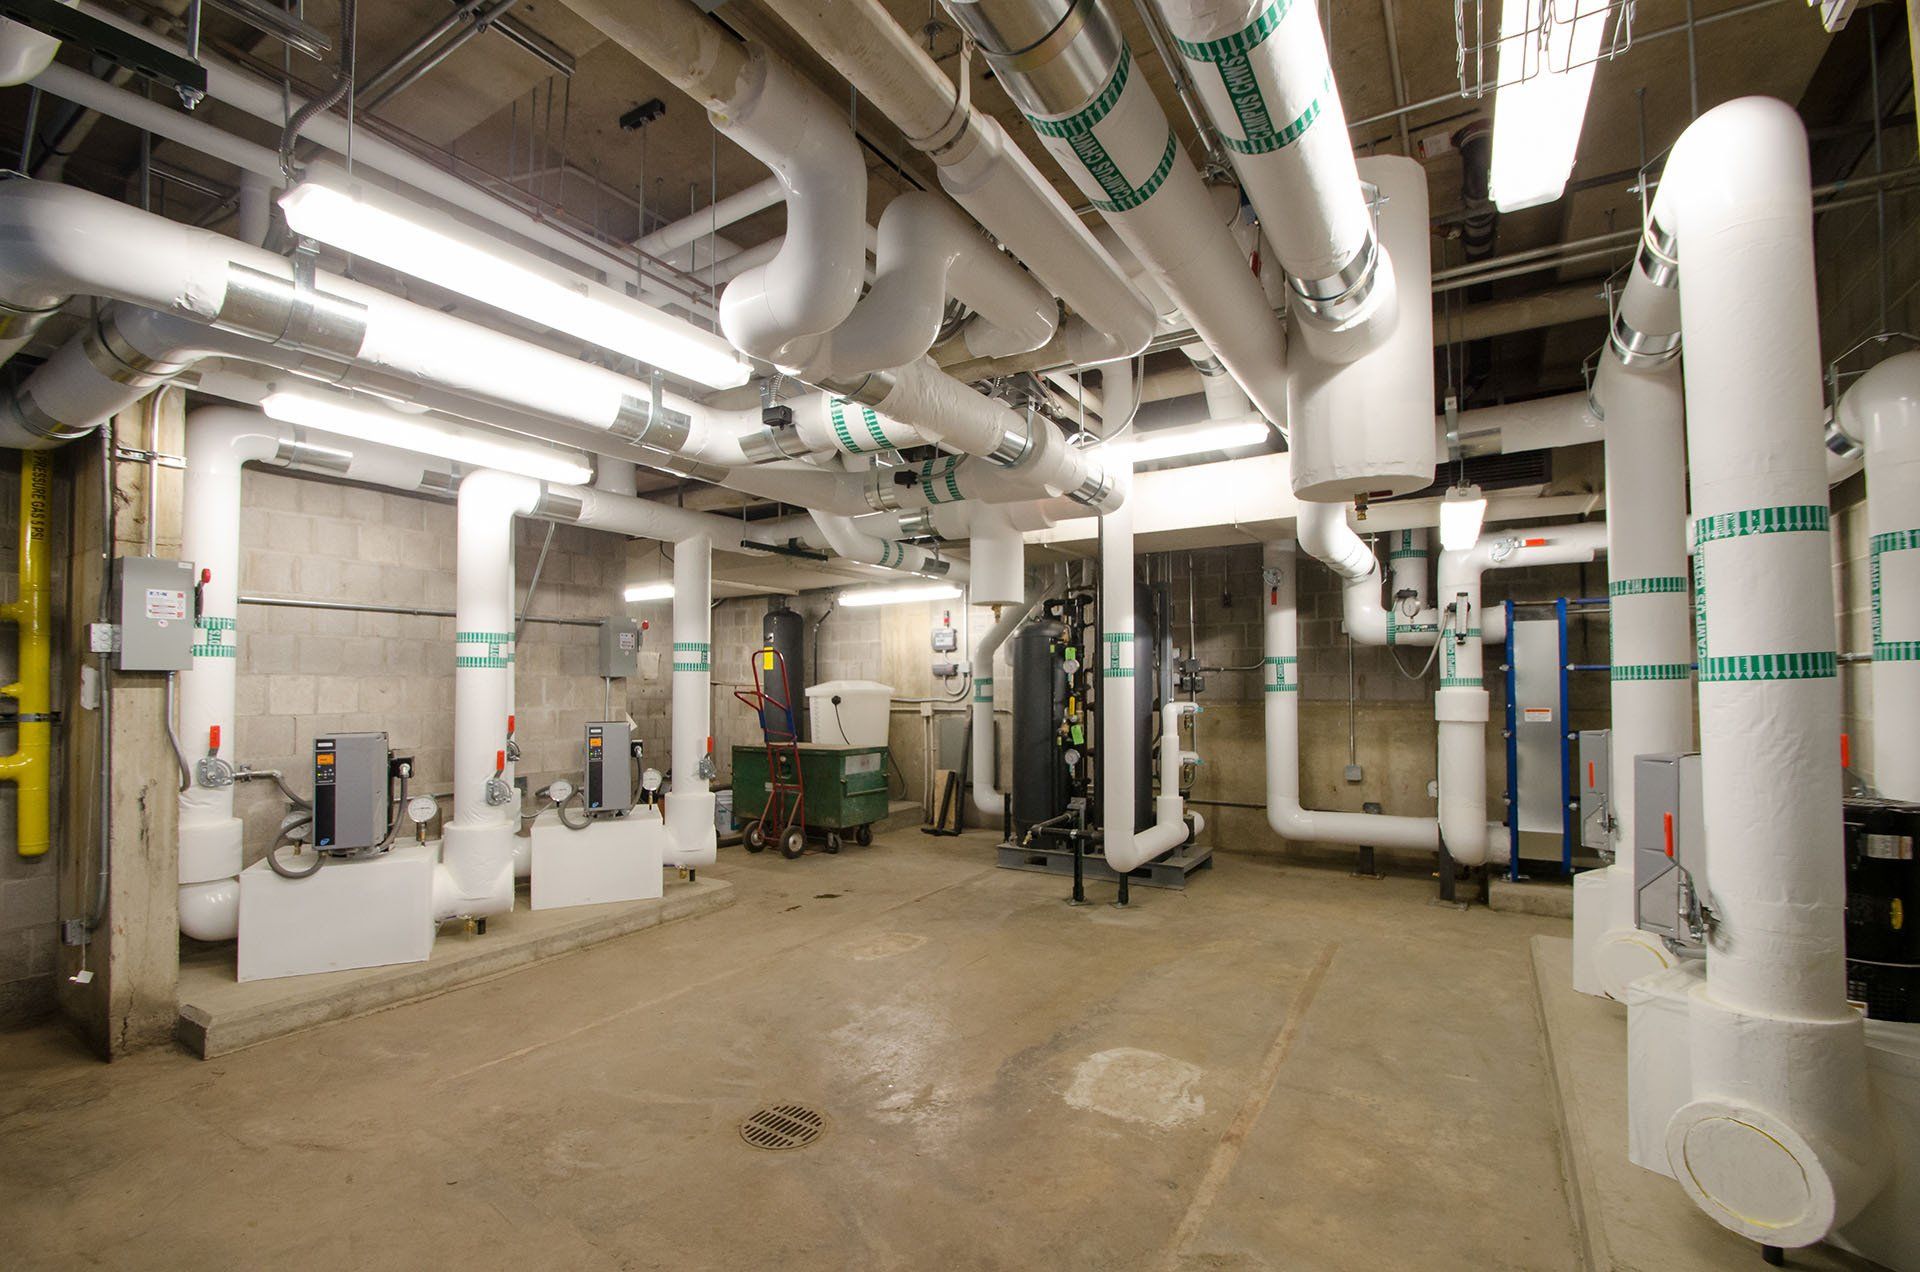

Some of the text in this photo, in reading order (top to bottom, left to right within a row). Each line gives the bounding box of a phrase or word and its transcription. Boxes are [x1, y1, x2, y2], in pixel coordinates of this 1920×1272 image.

[1220, 56, 1273, 140] CAMPUS CHWS
[1069, 129, 1132, 200] CAMPUS CHWR
[31, 456, 49, 500] PRESSURE
[31, 500, 46, 519] GAS
[31, 527, 45, 541] PSI
[208, 629, 222, 645] DTS
[1695, 593, 1708, 659] CAMPUS
